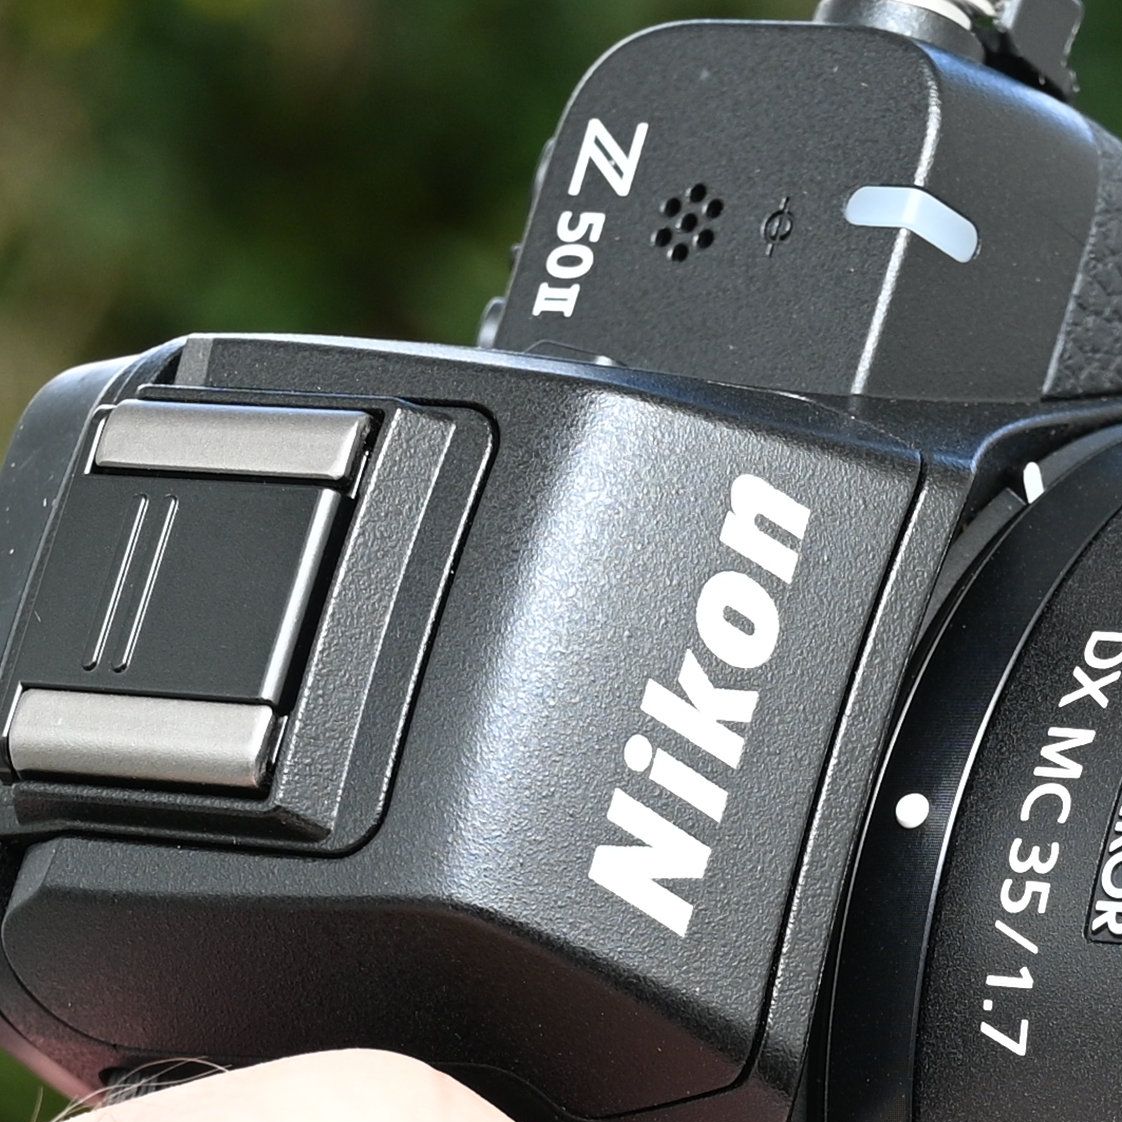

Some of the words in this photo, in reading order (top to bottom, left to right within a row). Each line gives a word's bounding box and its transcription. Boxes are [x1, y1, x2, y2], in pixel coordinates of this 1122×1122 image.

[567, 118, 649, 197] Z
[588, 473, 811, 938] Nikon
[1020, 726, 1097, 824] MC
[979, 837, 1060, 1057] 35/1.7
